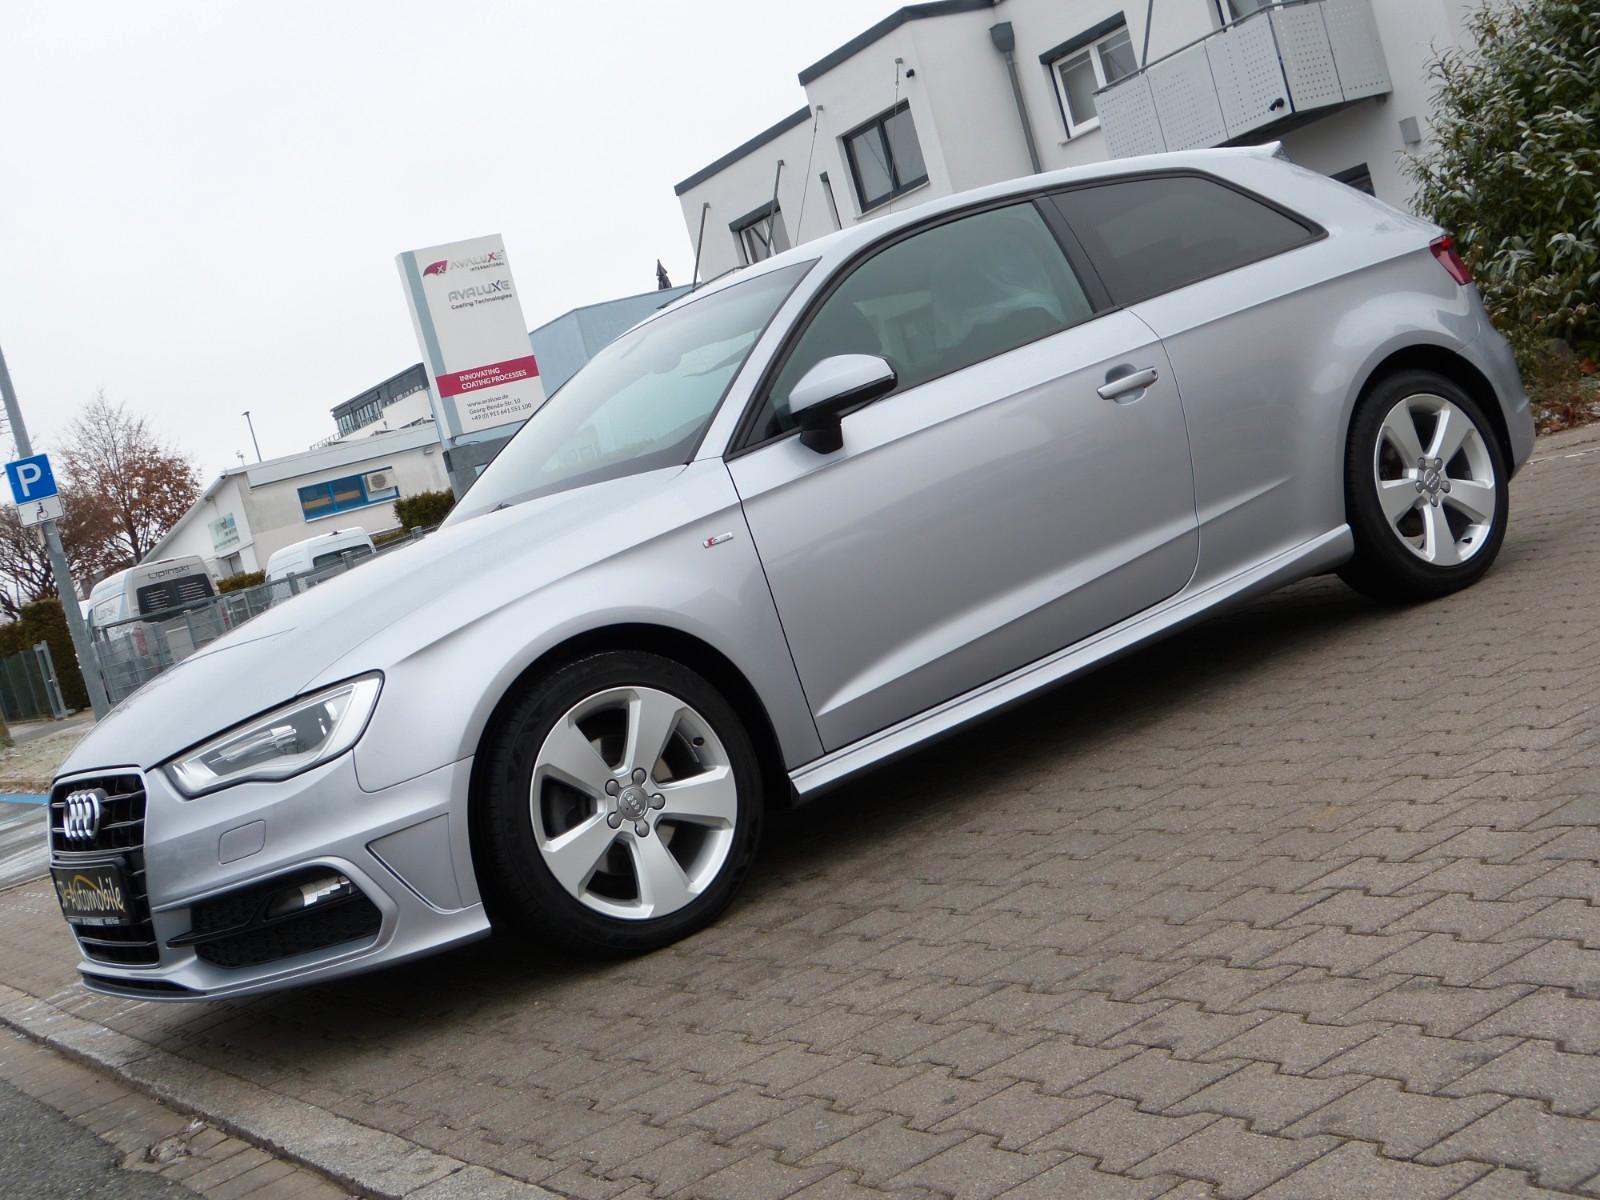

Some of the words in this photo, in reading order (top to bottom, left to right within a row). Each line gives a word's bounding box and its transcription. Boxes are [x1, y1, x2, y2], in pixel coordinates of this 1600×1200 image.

[448, 280, 511, 302] AVALUXE
[451, 301, 474, 310] Coating
[474, 294, 512, 305] Technologies
[459, 367, 500, 382] INNOVATING
[461, 377, 491, 390] COATING
[491, 369, 527, 382] PROCESSES
[16, 463, 42, 497] P
